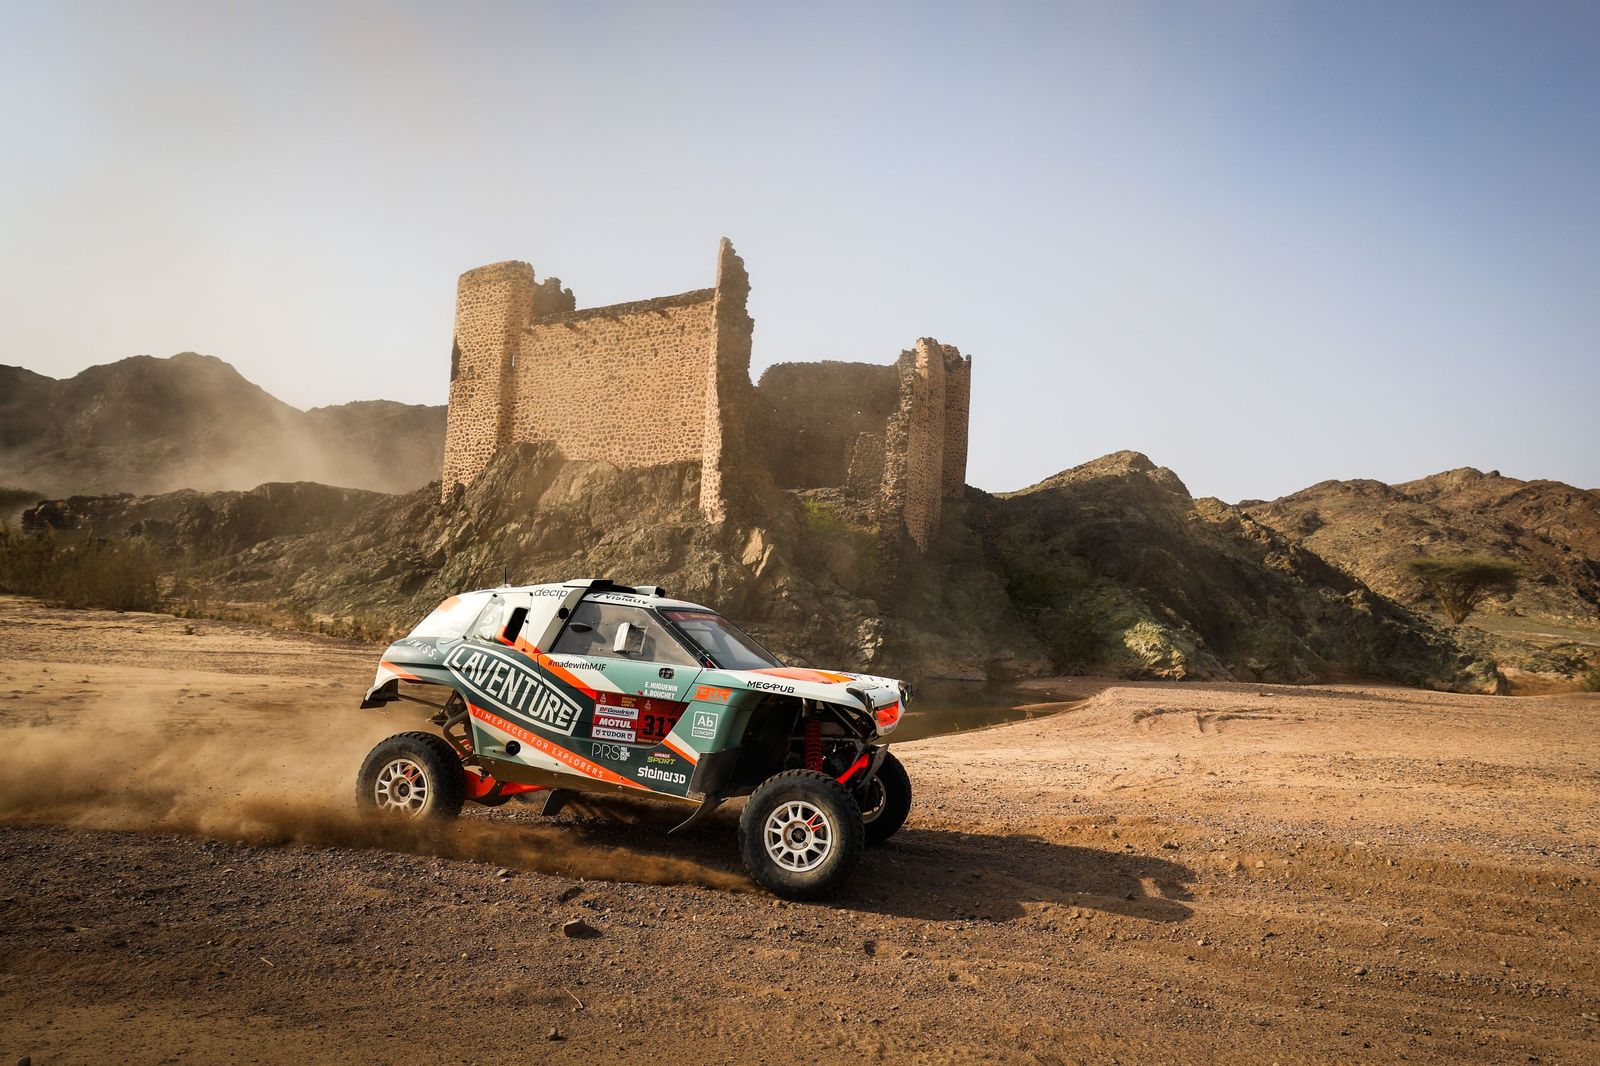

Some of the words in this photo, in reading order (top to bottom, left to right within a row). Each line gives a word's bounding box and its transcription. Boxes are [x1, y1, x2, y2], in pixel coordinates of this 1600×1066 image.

[547, 659, 607, 672] #madewithMJF
[451, 647, 573, 728] LAVENTURE
[600, 706, 635, 717] BFGoodrich
[599, 718, 632, 729] MOTUL
[697, 715, 714, 728] Ab
[602, 730, 627, 738] TUDOR
[474, 709, 527, 739] TIMEPIECES
[531, 737, 549, 750] FOR
[551, 749, 604, 778] EXPLORERS
[591, 742, 621, 761] PRS
[647, 756, 677, 766] SPORT
